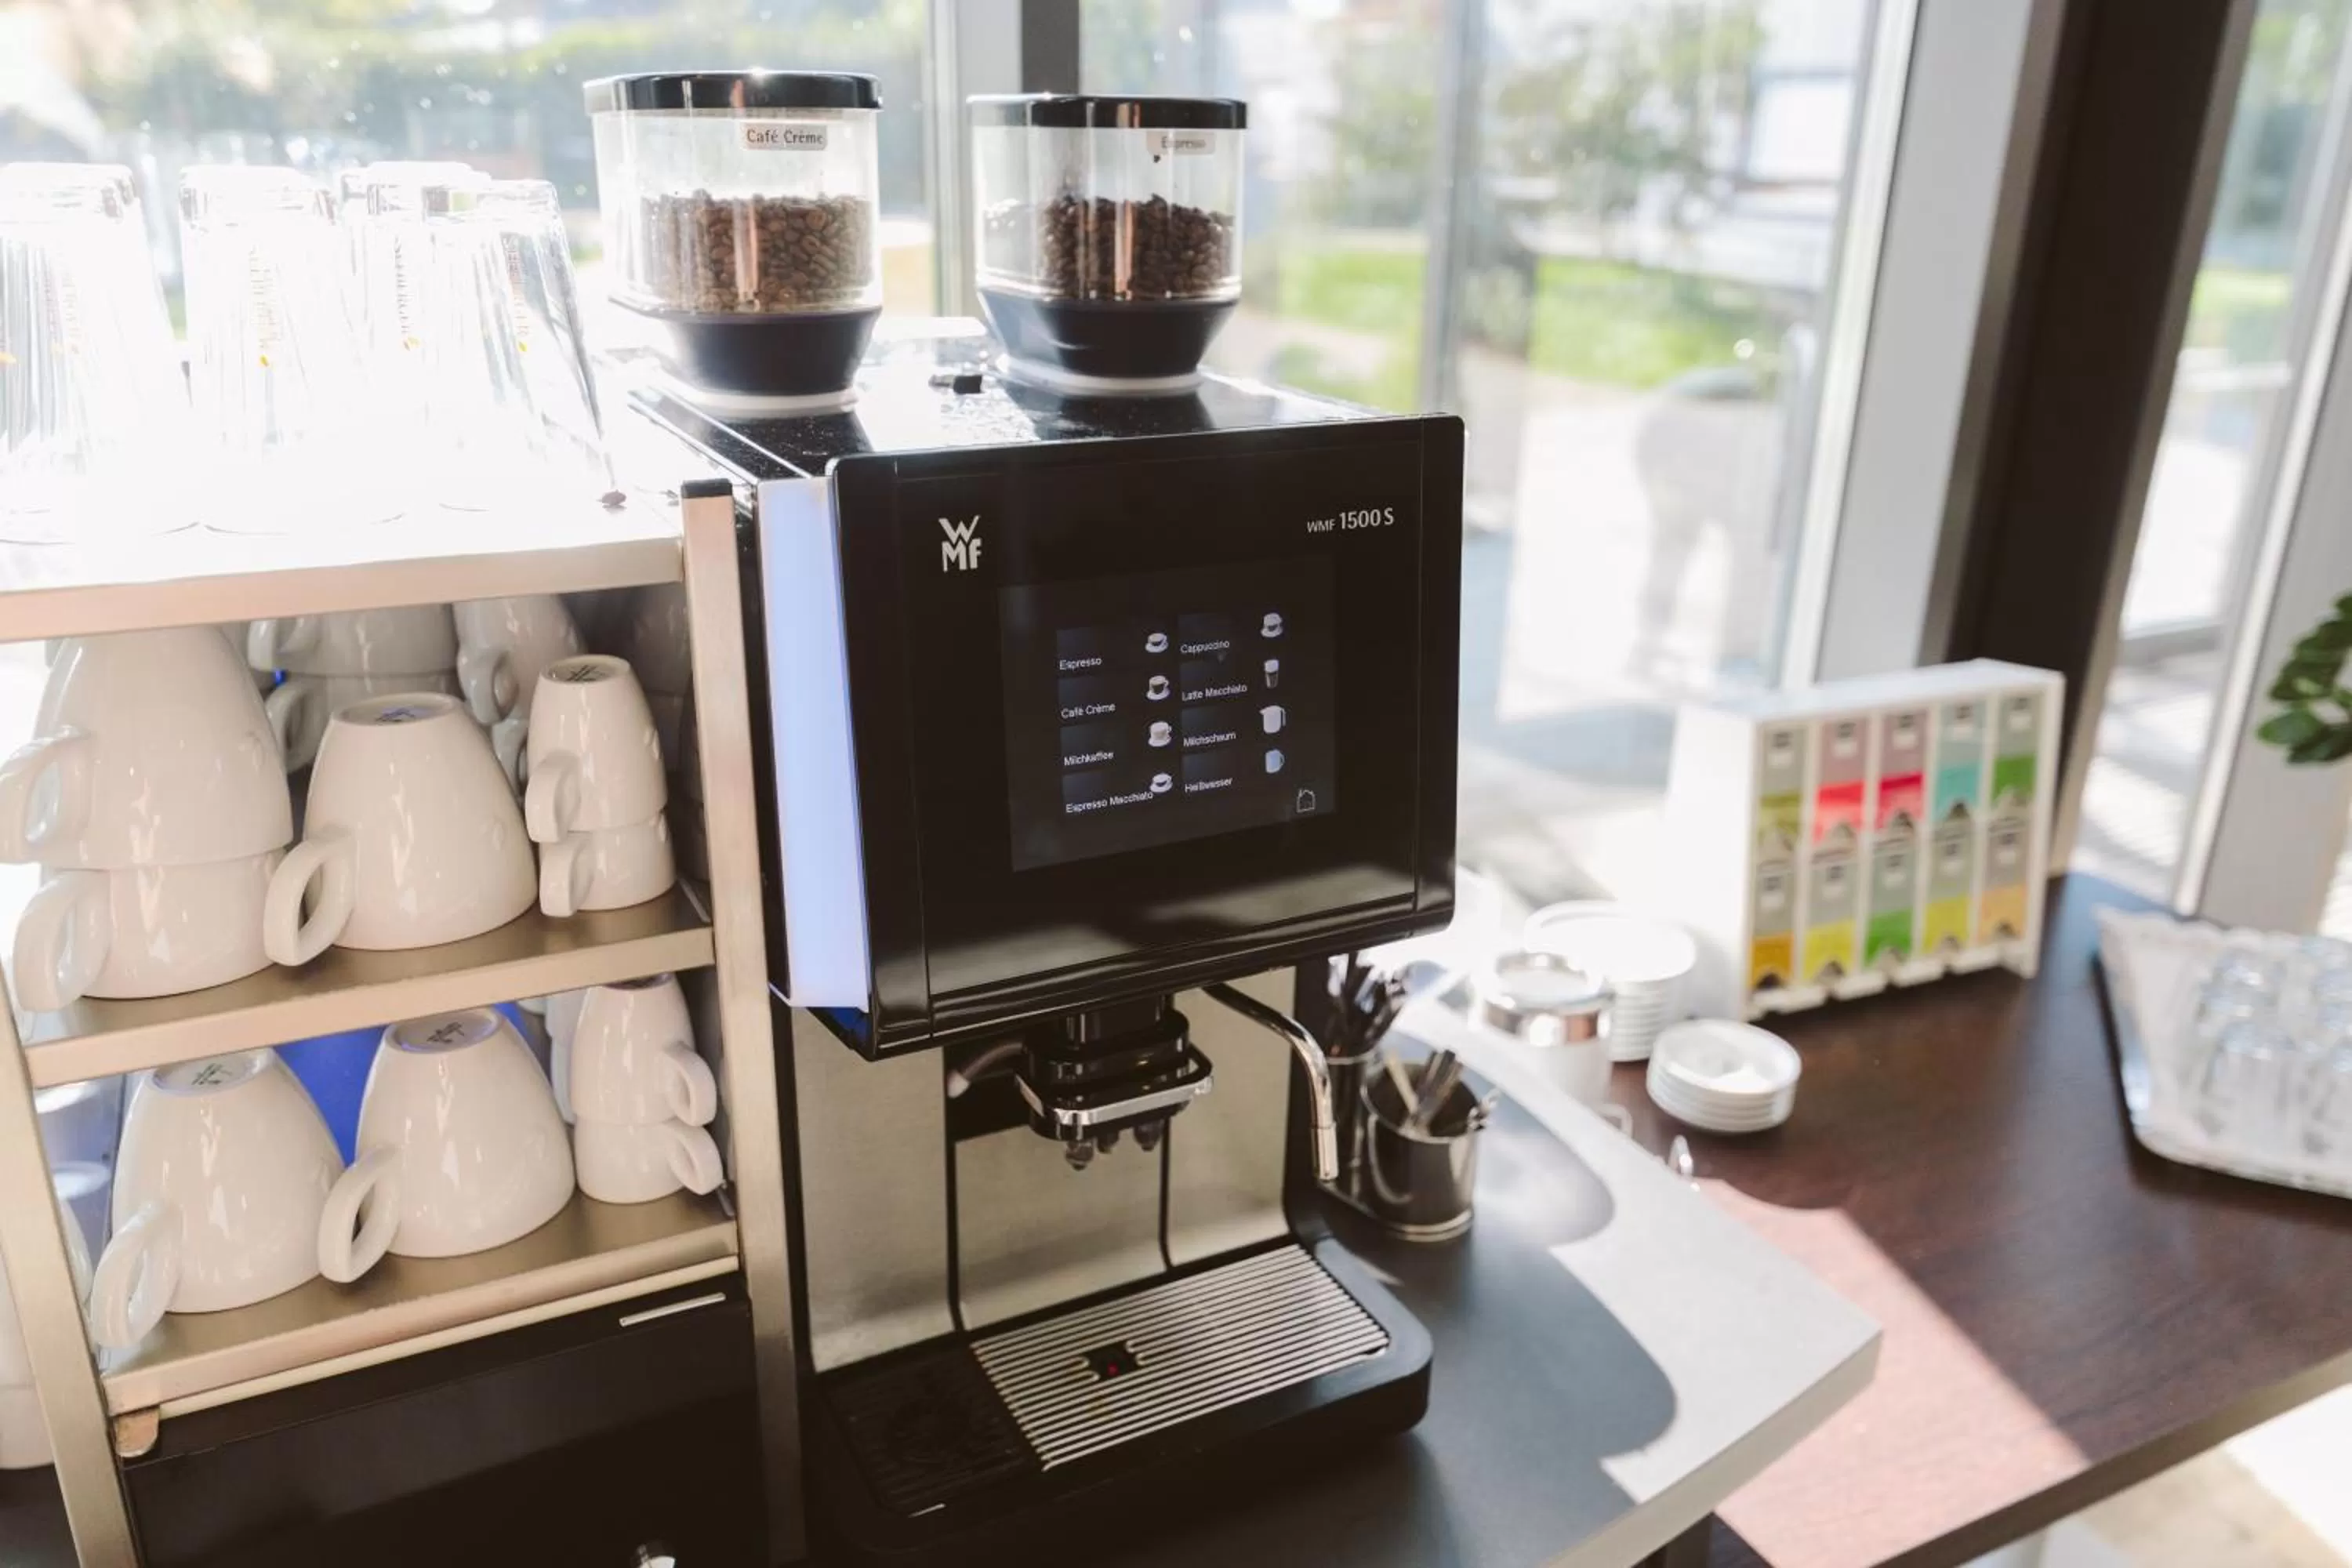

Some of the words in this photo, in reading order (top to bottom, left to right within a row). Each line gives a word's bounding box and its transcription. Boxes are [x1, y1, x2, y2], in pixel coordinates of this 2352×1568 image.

[746, 129, 779, 143] Café
[783, 129, 824, 145] Crème
[1307, 518, 1335, 533] WMF
[1339, 509, 1381, 529] 1500
[1383, 506, 1395, 526] S
[938, 514, 982, 572] WMF
[1059, 658, 1102, 671] Espresso
[1181, 691, 1204, 702] Latte
[1205, 683, 1248, 697] Macchiato
[1065, 799, 1108, 813] Espresso
[1109, 790, 1154, 806] Macchiato
